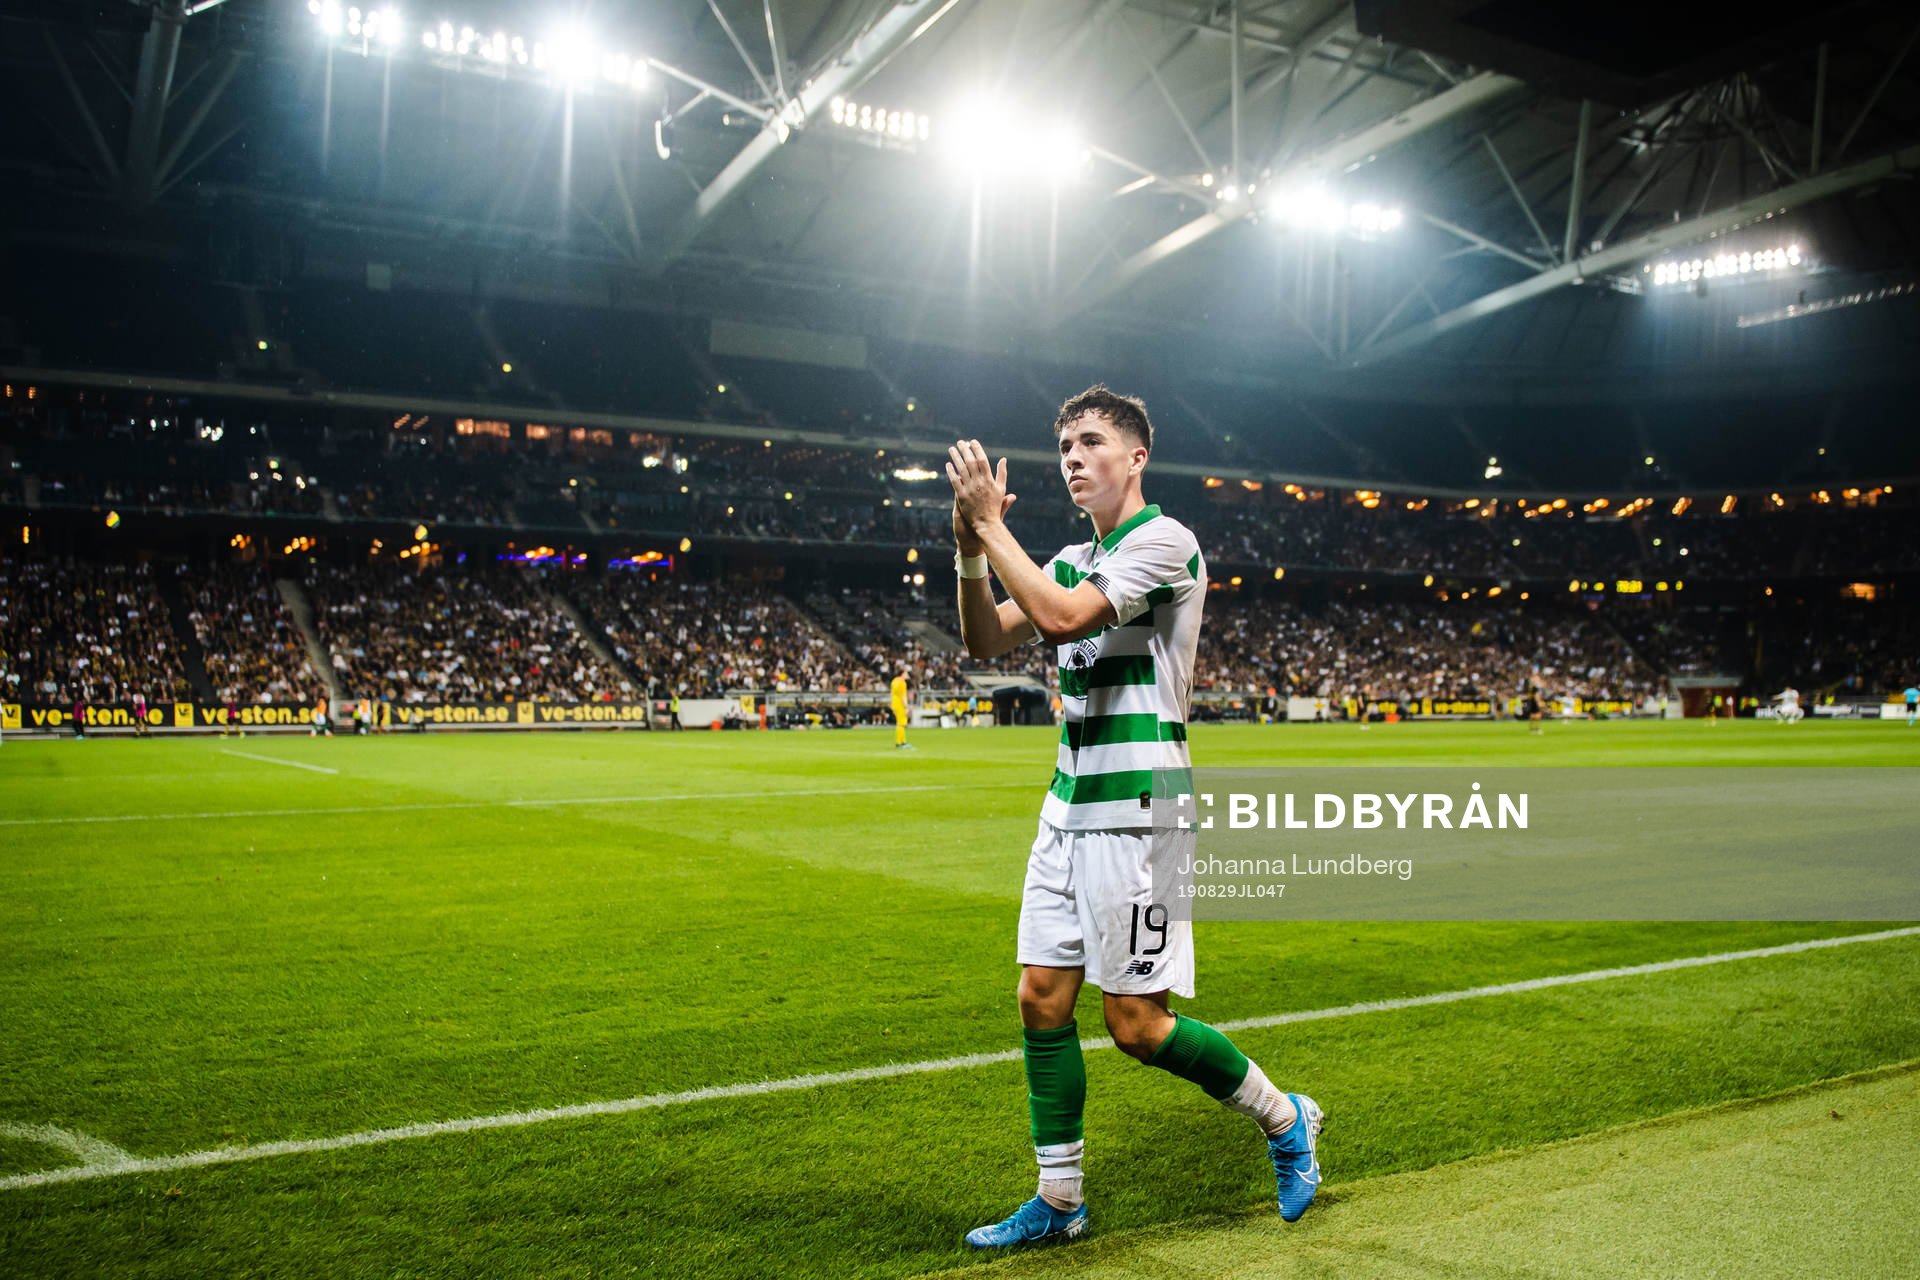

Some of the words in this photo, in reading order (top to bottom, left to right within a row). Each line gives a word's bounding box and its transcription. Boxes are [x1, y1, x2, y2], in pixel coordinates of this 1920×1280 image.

[31, 705, 164, 726] ve-ten.e
[540, 704, 644, 721] ve-sten.se
[1129, 903, 1169, 956] 19
